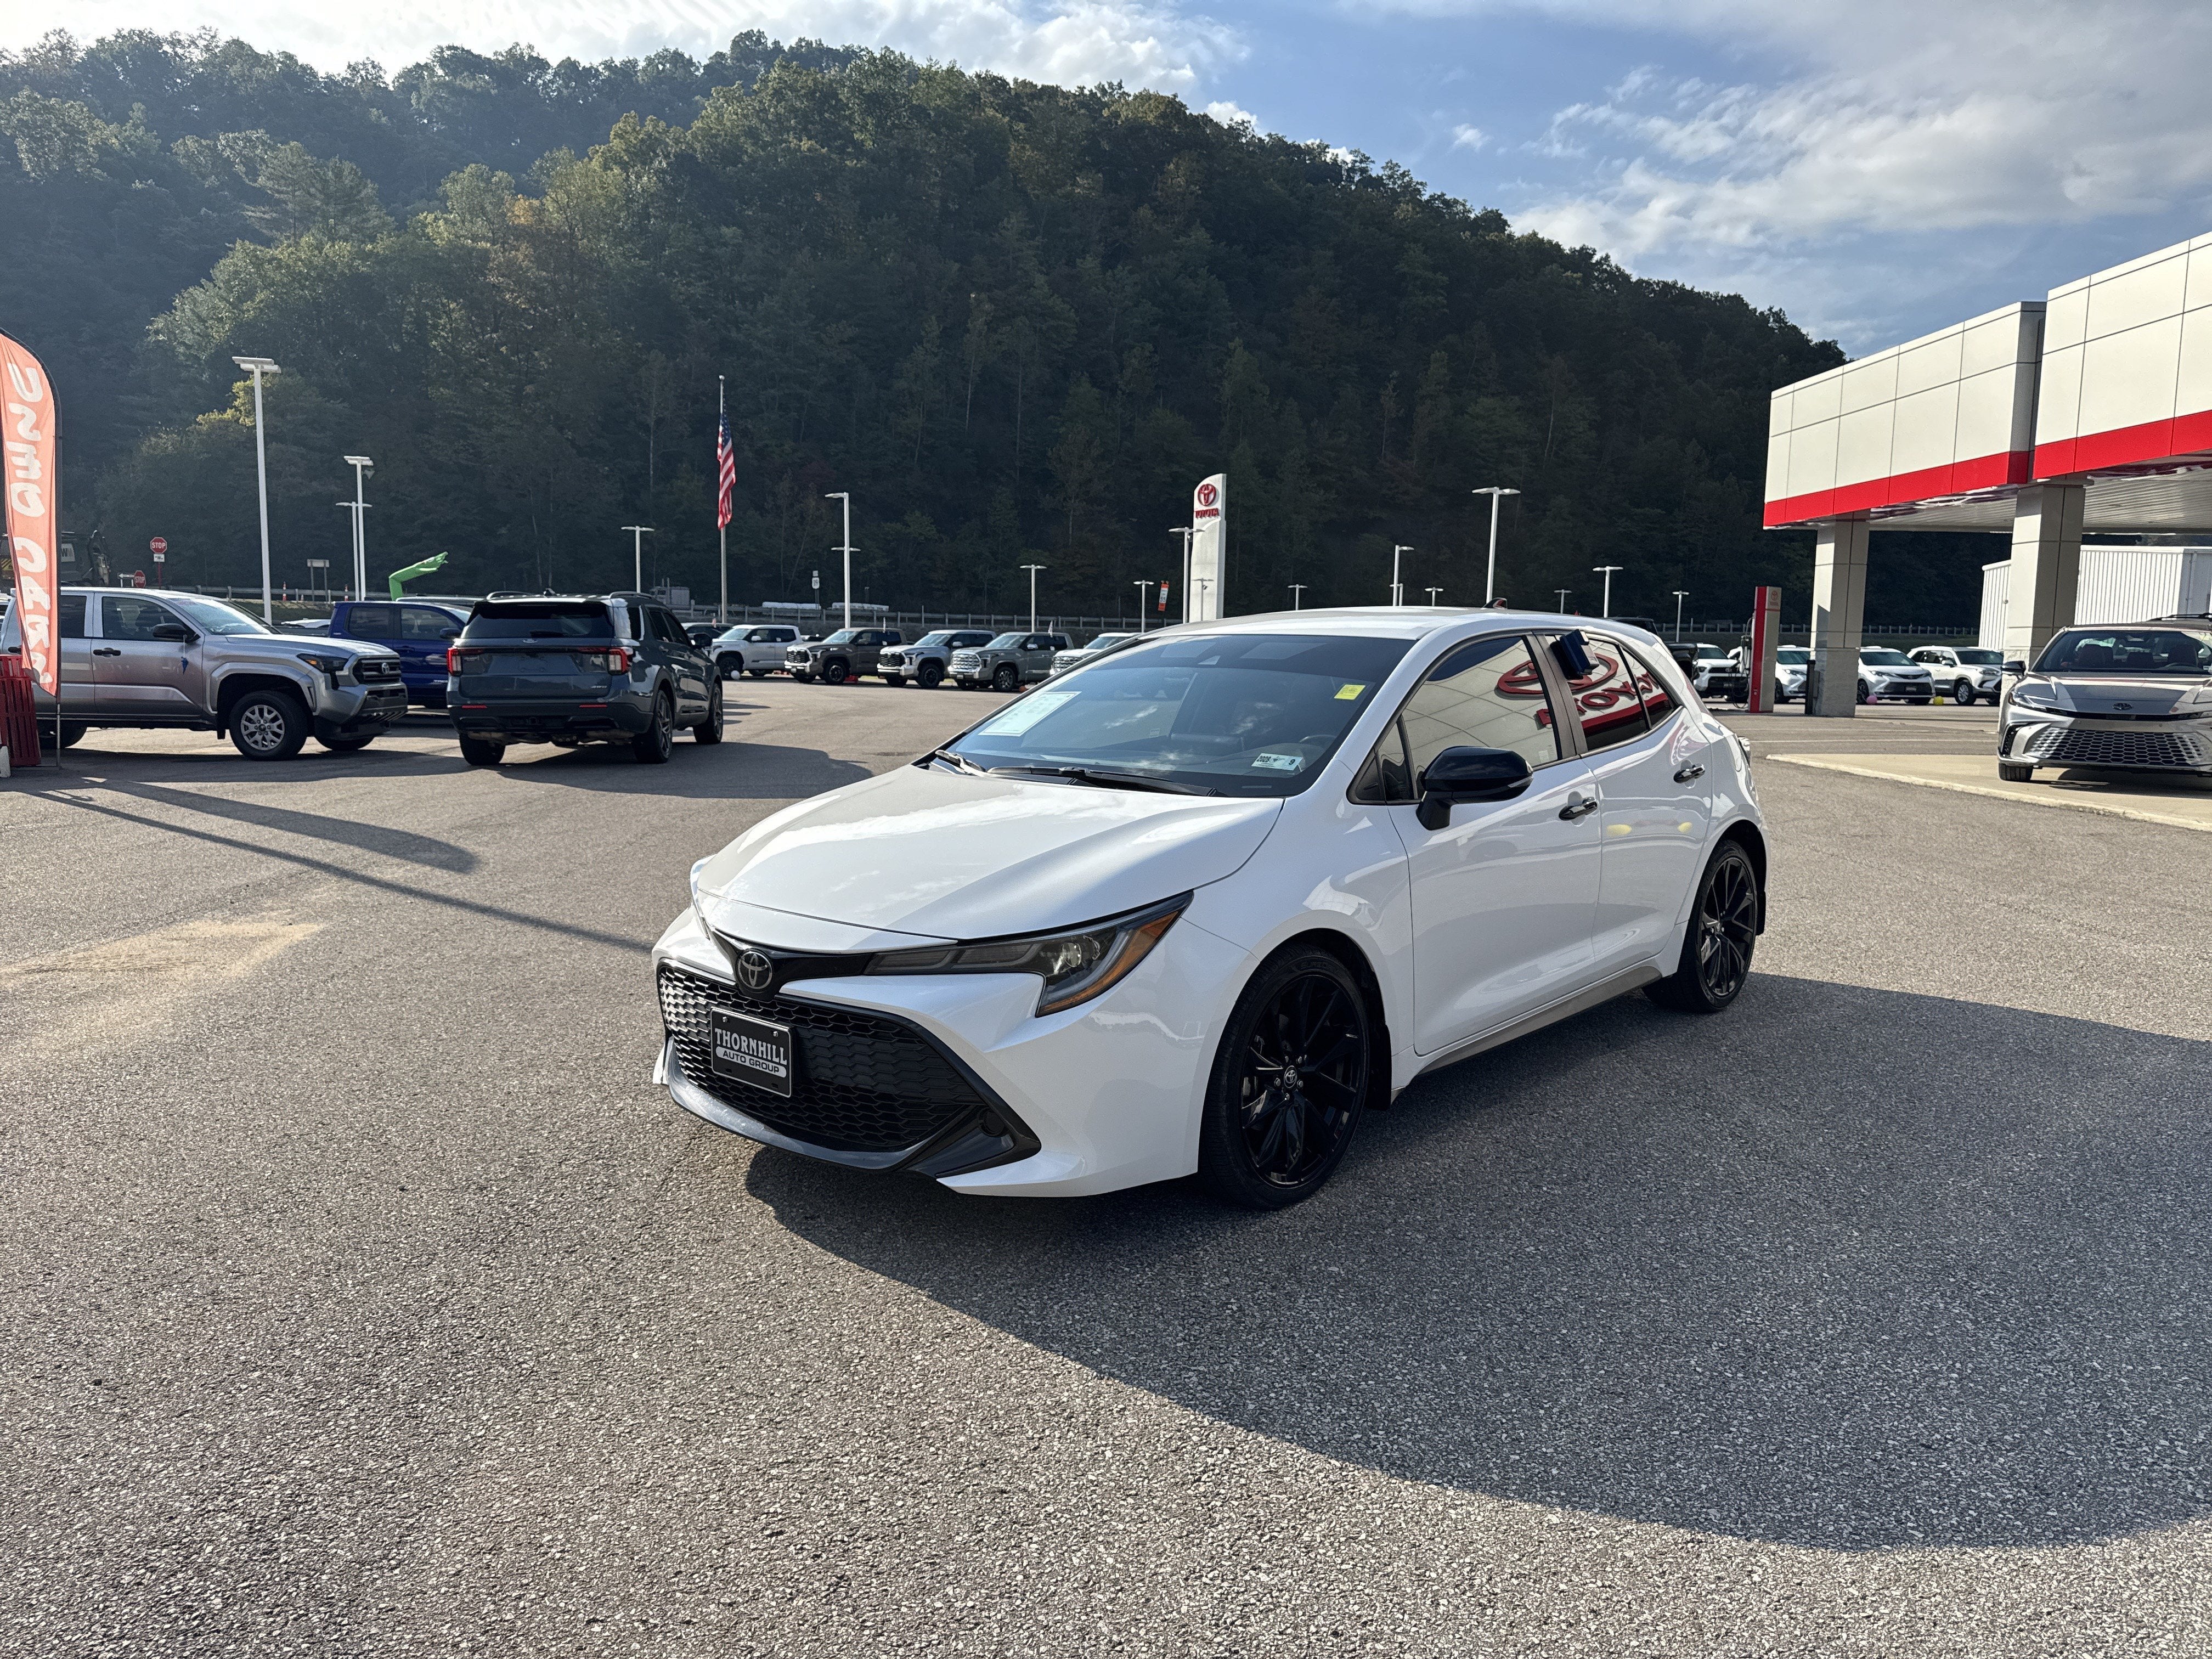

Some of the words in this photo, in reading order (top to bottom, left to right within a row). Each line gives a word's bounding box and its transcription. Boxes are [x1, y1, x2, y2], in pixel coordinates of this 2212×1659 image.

[1195, 508, 1220, 518] TOYOTA
[714, 1028, 787, 1065] THORNHILL
[723, 1050, 746, 1063] AUTO
[749, 1058, 779, 1073] GROUP
